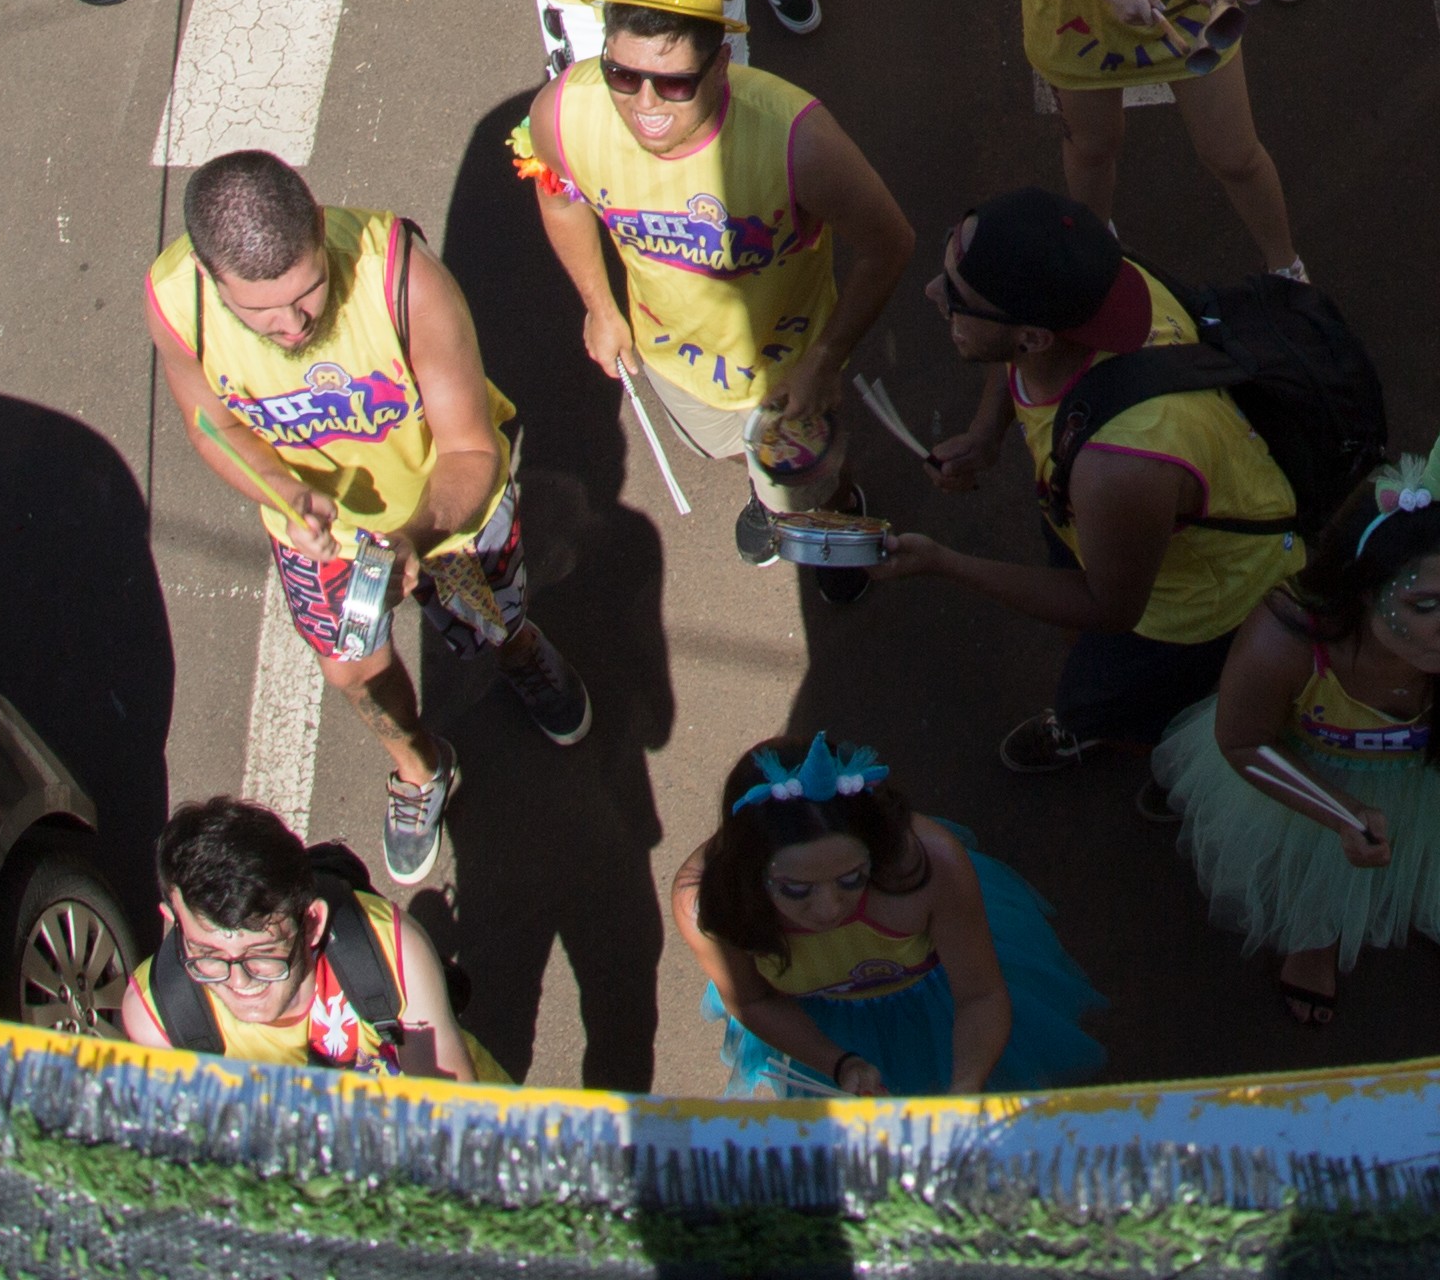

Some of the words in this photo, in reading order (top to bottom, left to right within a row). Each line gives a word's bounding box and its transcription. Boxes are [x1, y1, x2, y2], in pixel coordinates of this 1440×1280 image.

[640, 212, 691, 239] OI
[619, 221, 765, 272] Sumida
[251, 396, 405, 447] Sumida
[263, 391, 324, 423] OI
[1354, 730, 1413, 752] OI
